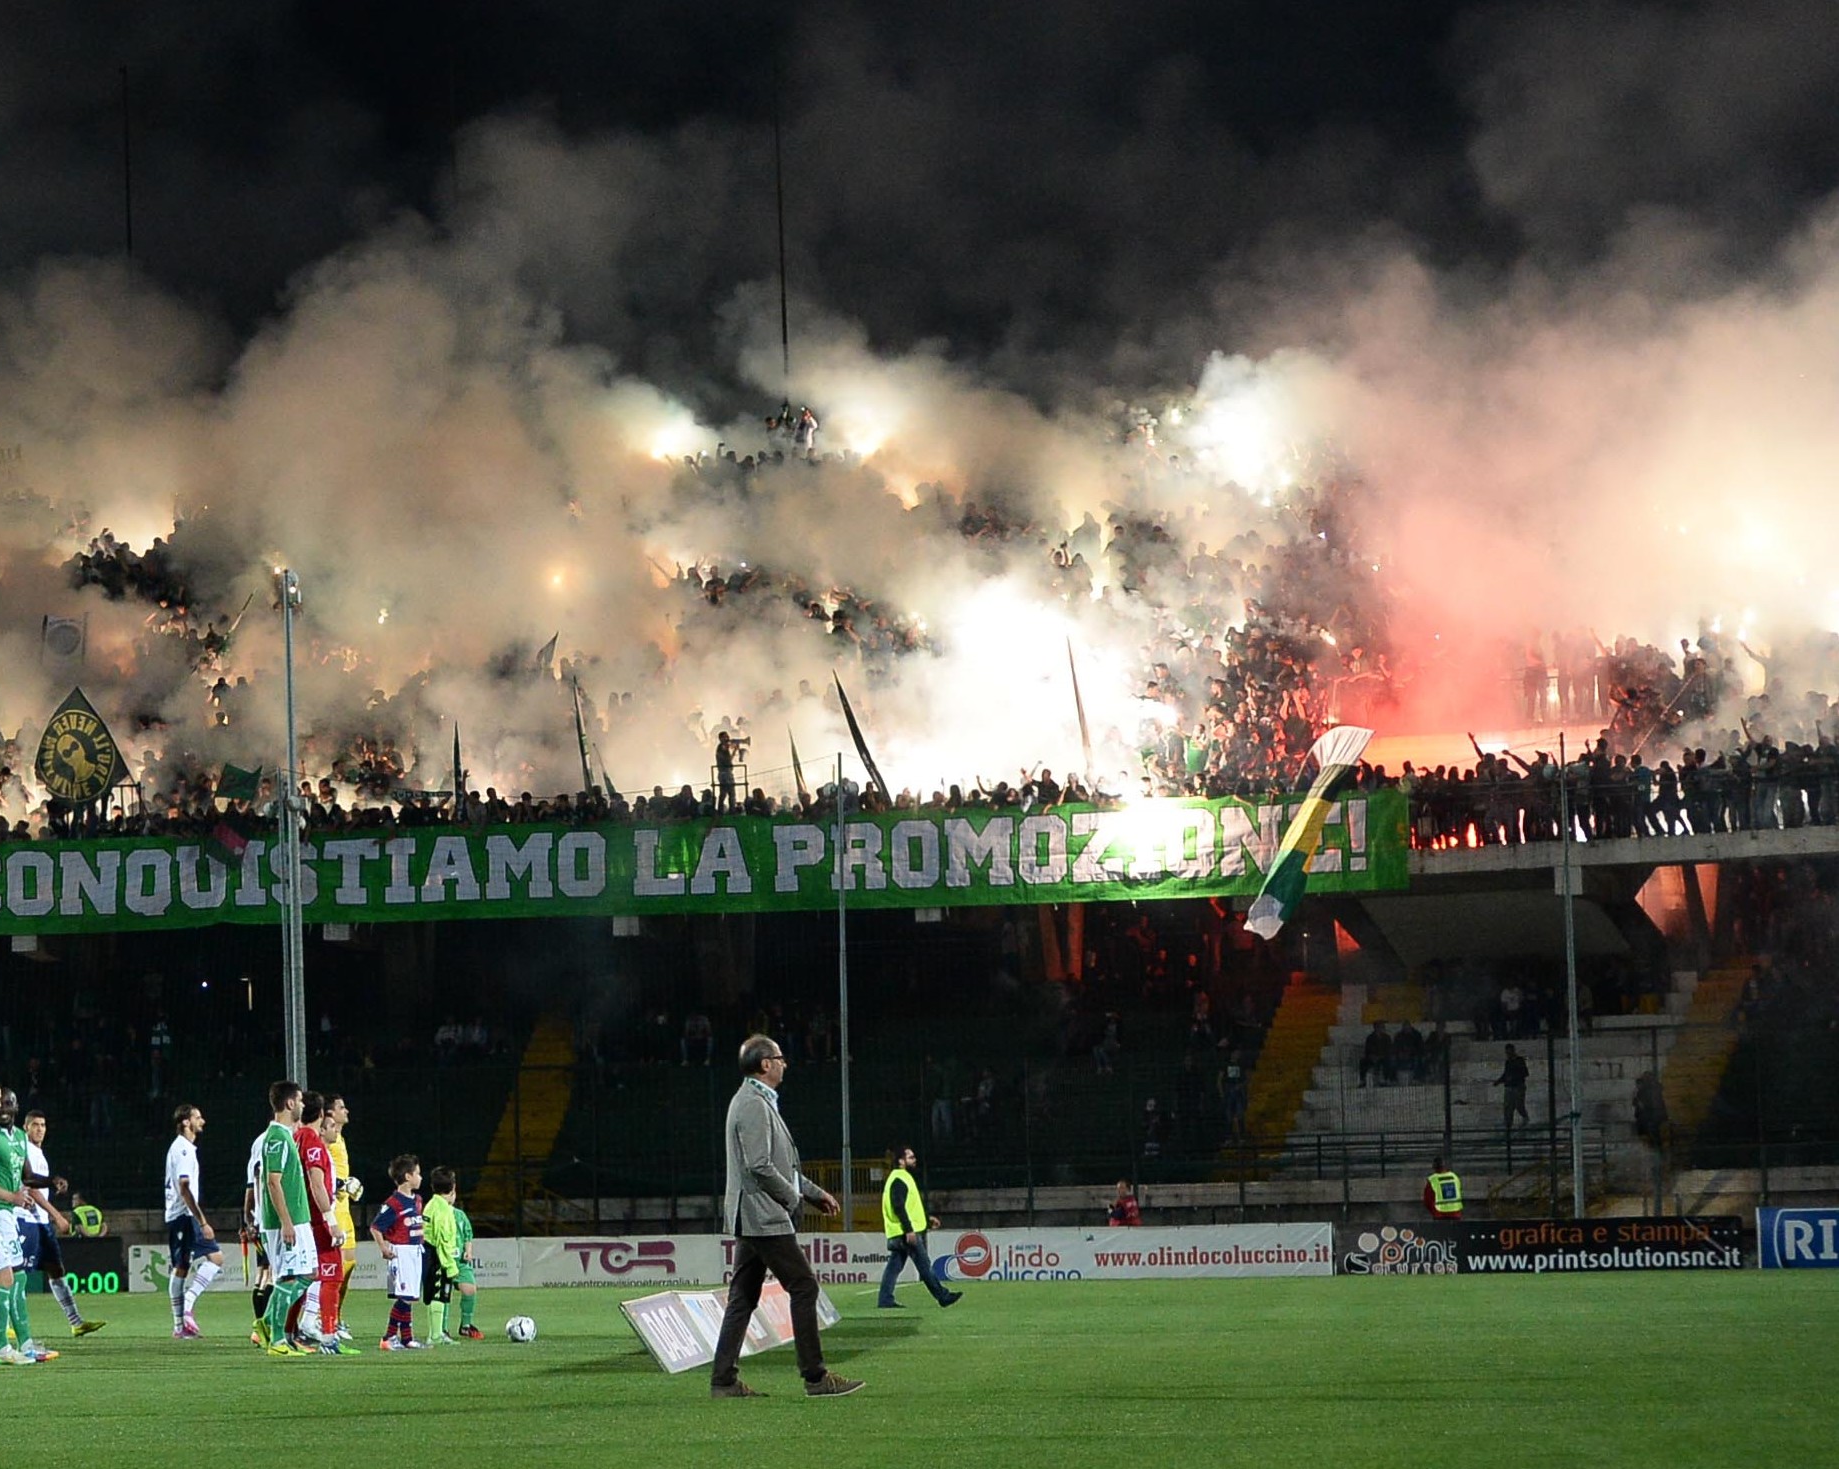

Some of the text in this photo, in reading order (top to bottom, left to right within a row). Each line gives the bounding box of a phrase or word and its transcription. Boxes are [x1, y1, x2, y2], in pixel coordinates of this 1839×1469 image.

[632, 826, 753, 897] LA
[1593, 1225, 1609, 1242] e
[1094, 1243, 1330, 1267] www.olindocoluccino.it
[1468, 1246, 1741, 1273] www.printsolutionsnc.it
